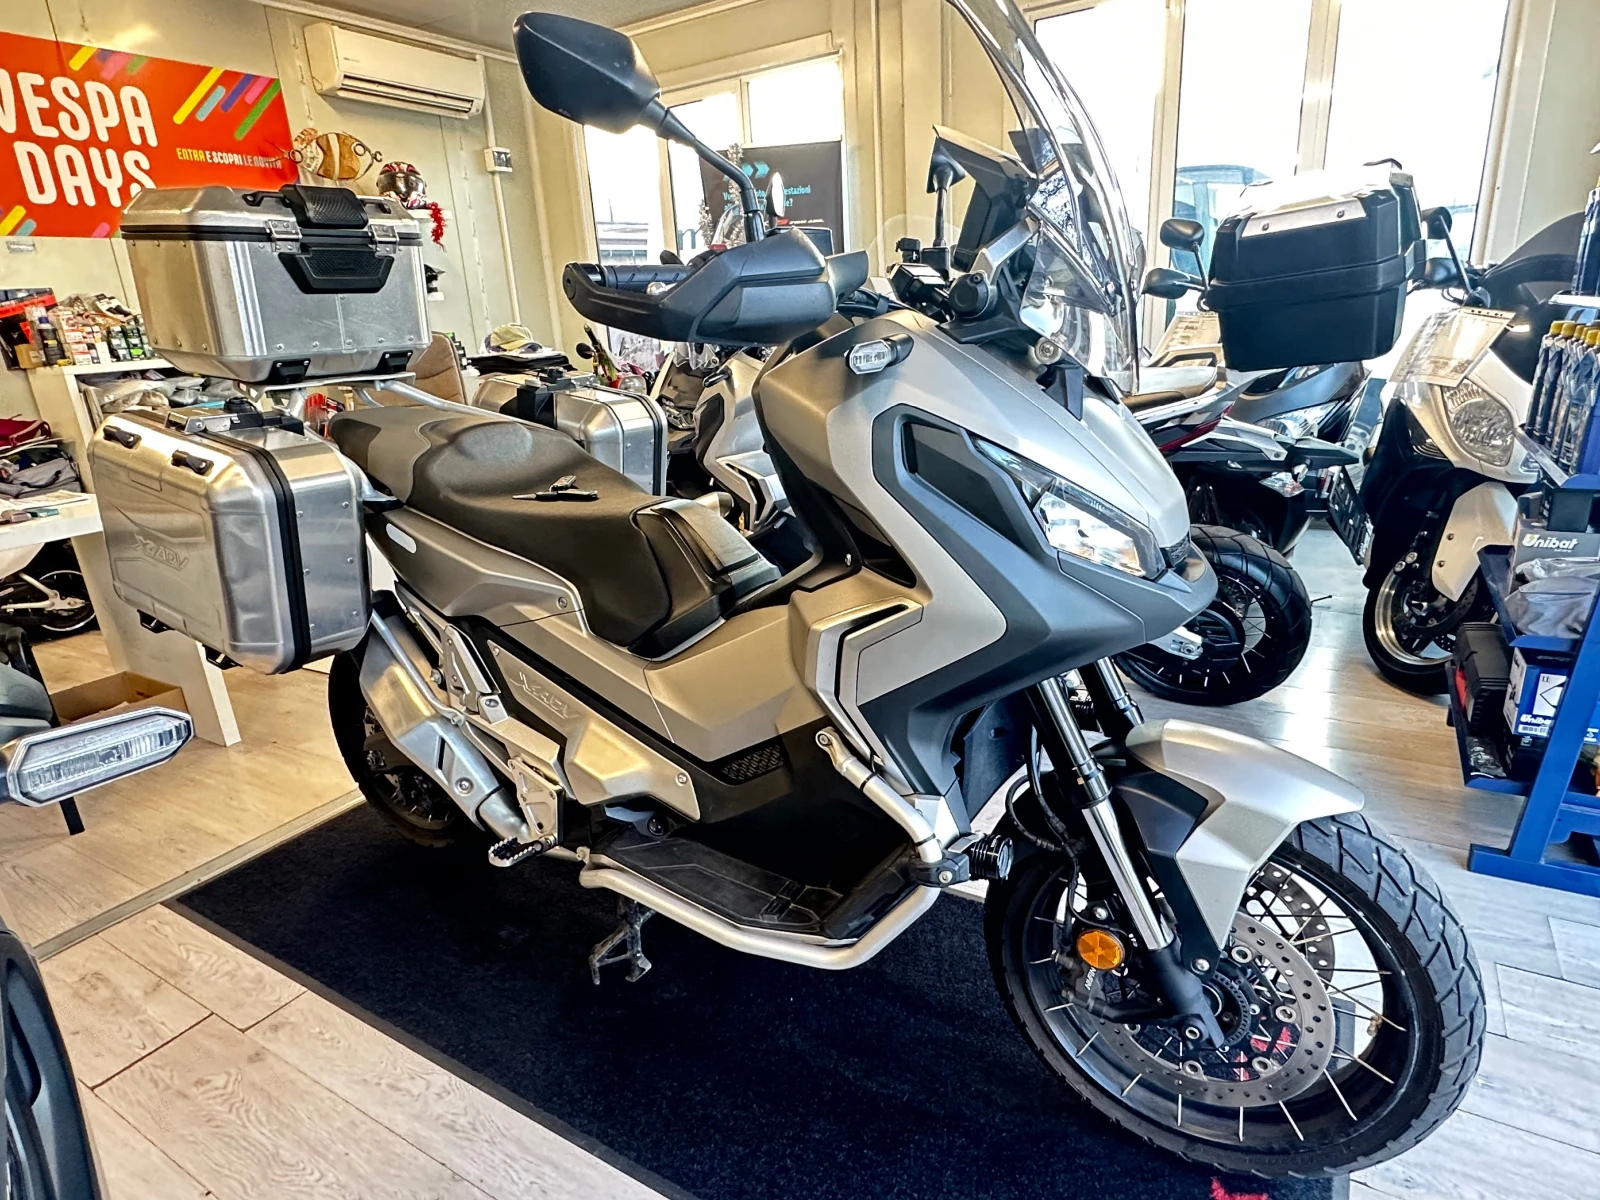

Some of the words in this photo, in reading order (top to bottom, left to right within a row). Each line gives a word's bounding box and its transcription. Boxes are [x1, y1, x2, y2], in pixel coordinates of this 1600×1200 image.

[176, 148, 205, 162] ENTRA
[13, 140, 157, 208] DAYS
[1522, 534, 1578, 549] Unibat
[1520, 713, 1552, 726] Uniba
